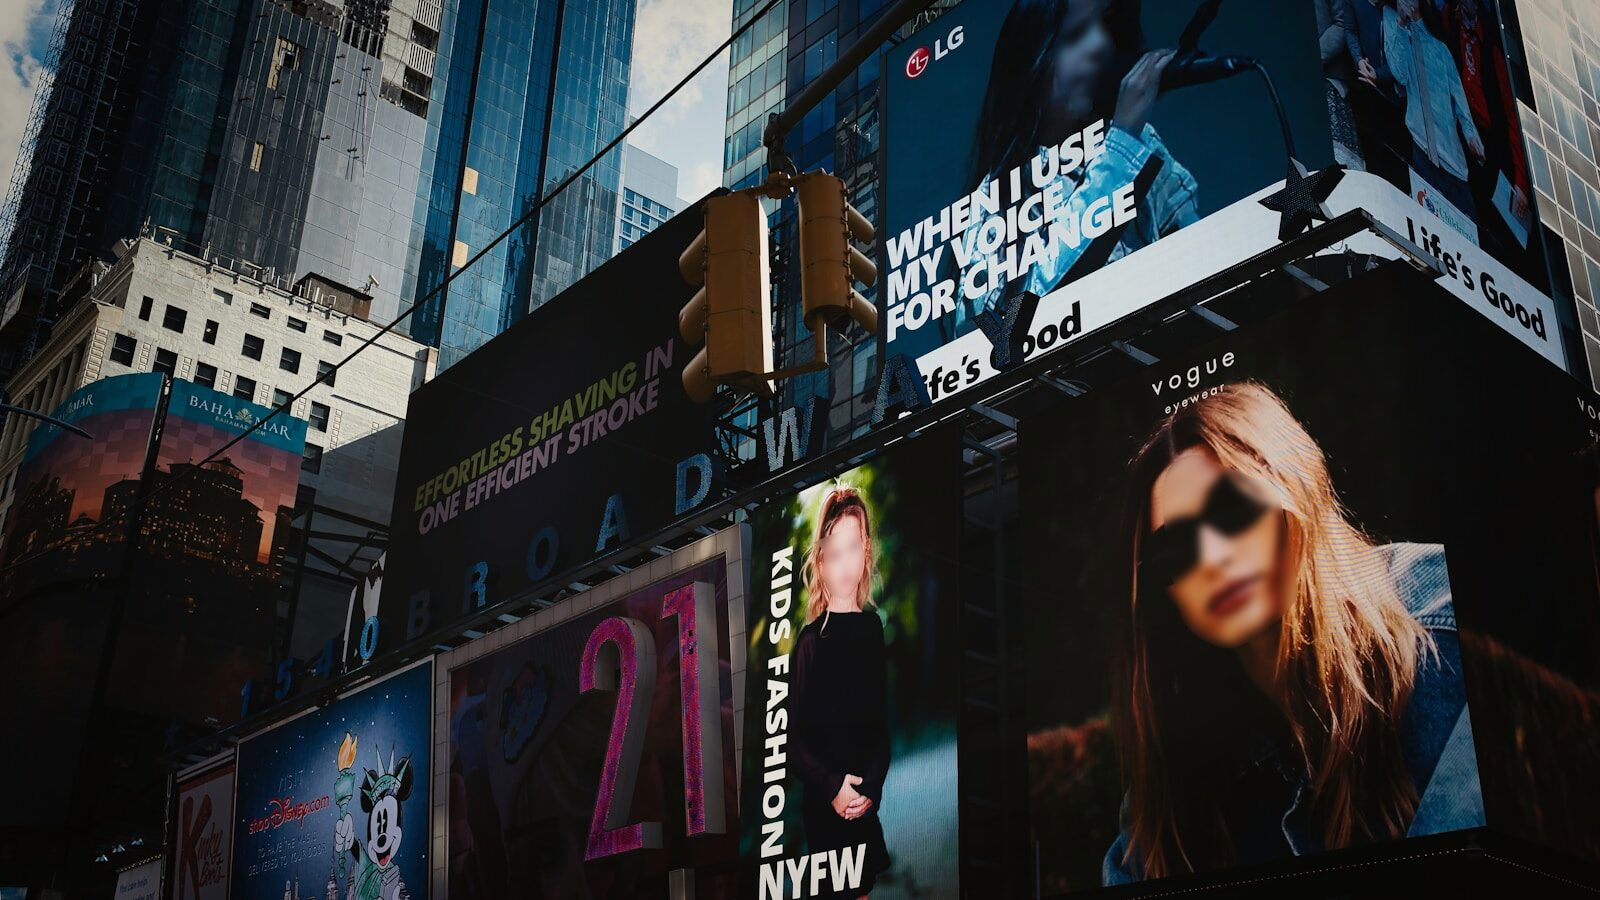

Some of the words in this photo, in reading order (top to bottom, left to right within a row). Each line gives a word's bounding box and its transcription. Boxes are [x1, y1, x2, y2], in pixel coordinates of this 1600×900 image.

[935, 25, 964, 61] LG
[886, 178, 1000, 269] WHEN
[1010, 166, 1022, 203] I
[1031, 119, 1106, 189] USE
[887, 278, 956, 343] FOR
[963, 181, 1137, 299] CHANGE
[887, 245, 944, 306] MY
[1480, 272, 1547, 341] Good
[922, 354, 980, 401] fe's
[990, 301, 1081, 369] ood
[1152, 351, 1235, 396] vogue
[1164, 383, 1225, 414] eyewear
[190, 395, 234, 419] BAHA
[414, 426, 523, 511] EFFORTLESS
[528, 361, 637, 446] SHAVING
[644, 338, 674, 380] IN
[418, 490, 461, 535] ONE
[464, 433, 562, 511] EFFICIENT
[567, 378, 660, 455] STROKE
[768, 546, 794, 645] KIDS
[579, 581, 726, 862] 21
[761, 653, 790, 858] FASHION
[758, 843, 867, 900] NYFW
